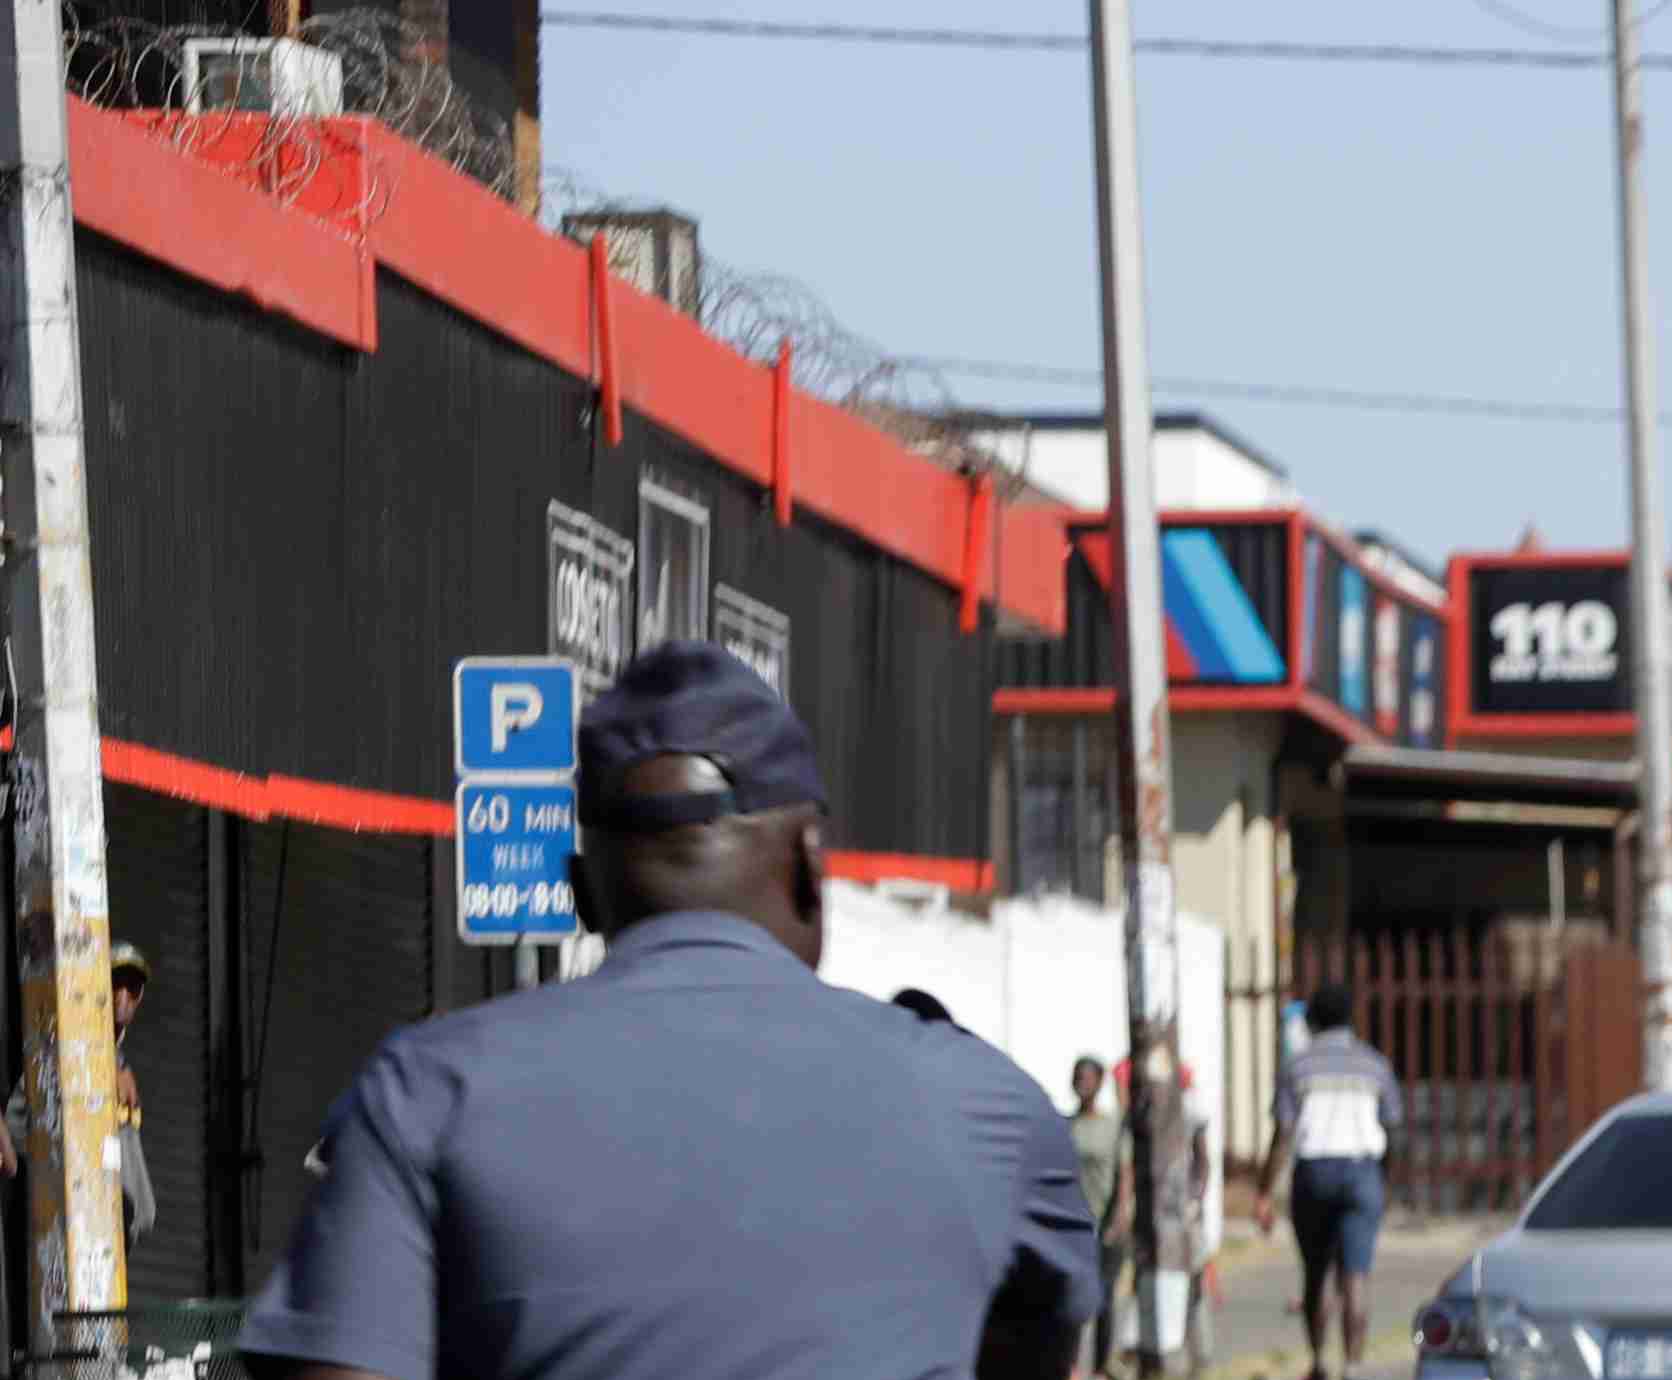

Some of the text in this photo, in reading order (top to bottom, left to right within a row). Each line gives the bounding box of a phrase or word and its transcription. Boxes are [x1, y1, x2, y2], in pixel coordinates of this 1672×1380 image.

[1489, 600, 1618, 656] 110
[490, 682, 544, 753] P
[467, 794, 510, 834] 60
